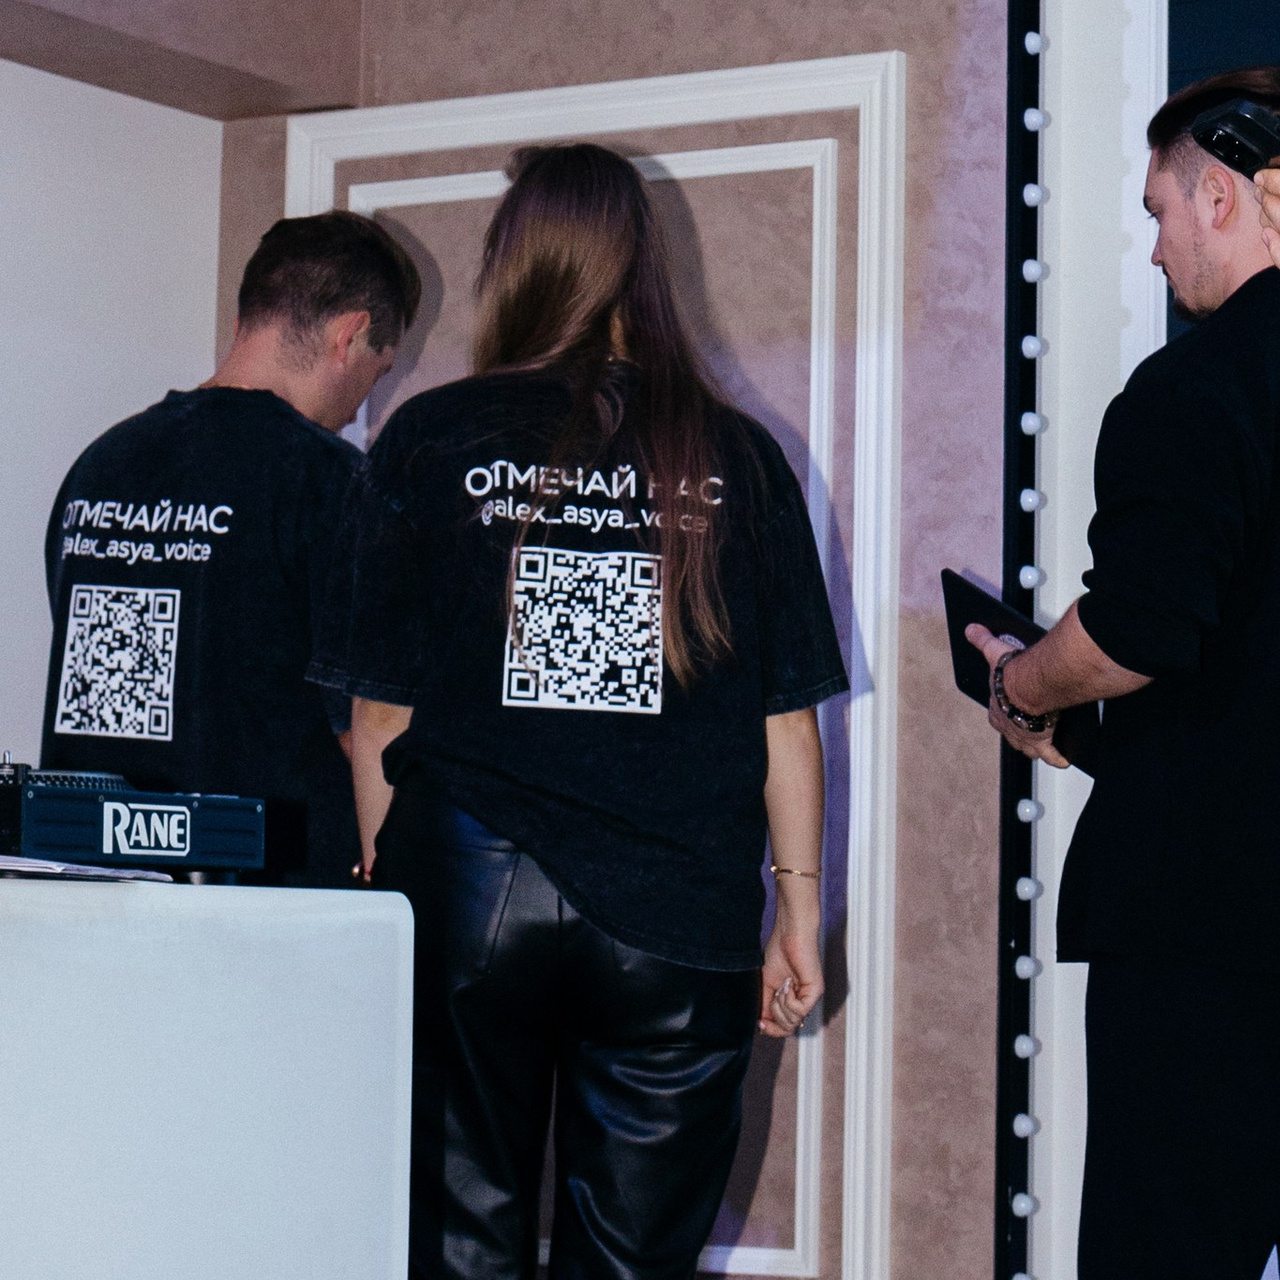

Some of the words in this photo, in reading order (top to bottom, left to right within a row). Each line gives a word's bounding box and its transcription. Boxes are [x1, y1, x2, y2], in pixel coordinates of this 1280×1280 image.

[465, 460, 637, 500] ОТМЕЧАЙ
[62, 499, 173, 533] ОТМЕЧАЙ
[173, 504, 234, 535] НАС
[481, 495, 709, 534] @alex_asya_voce
[62, 532, 213, 566] alex_asya_voice
[103, 801, 190, 857] RANE
